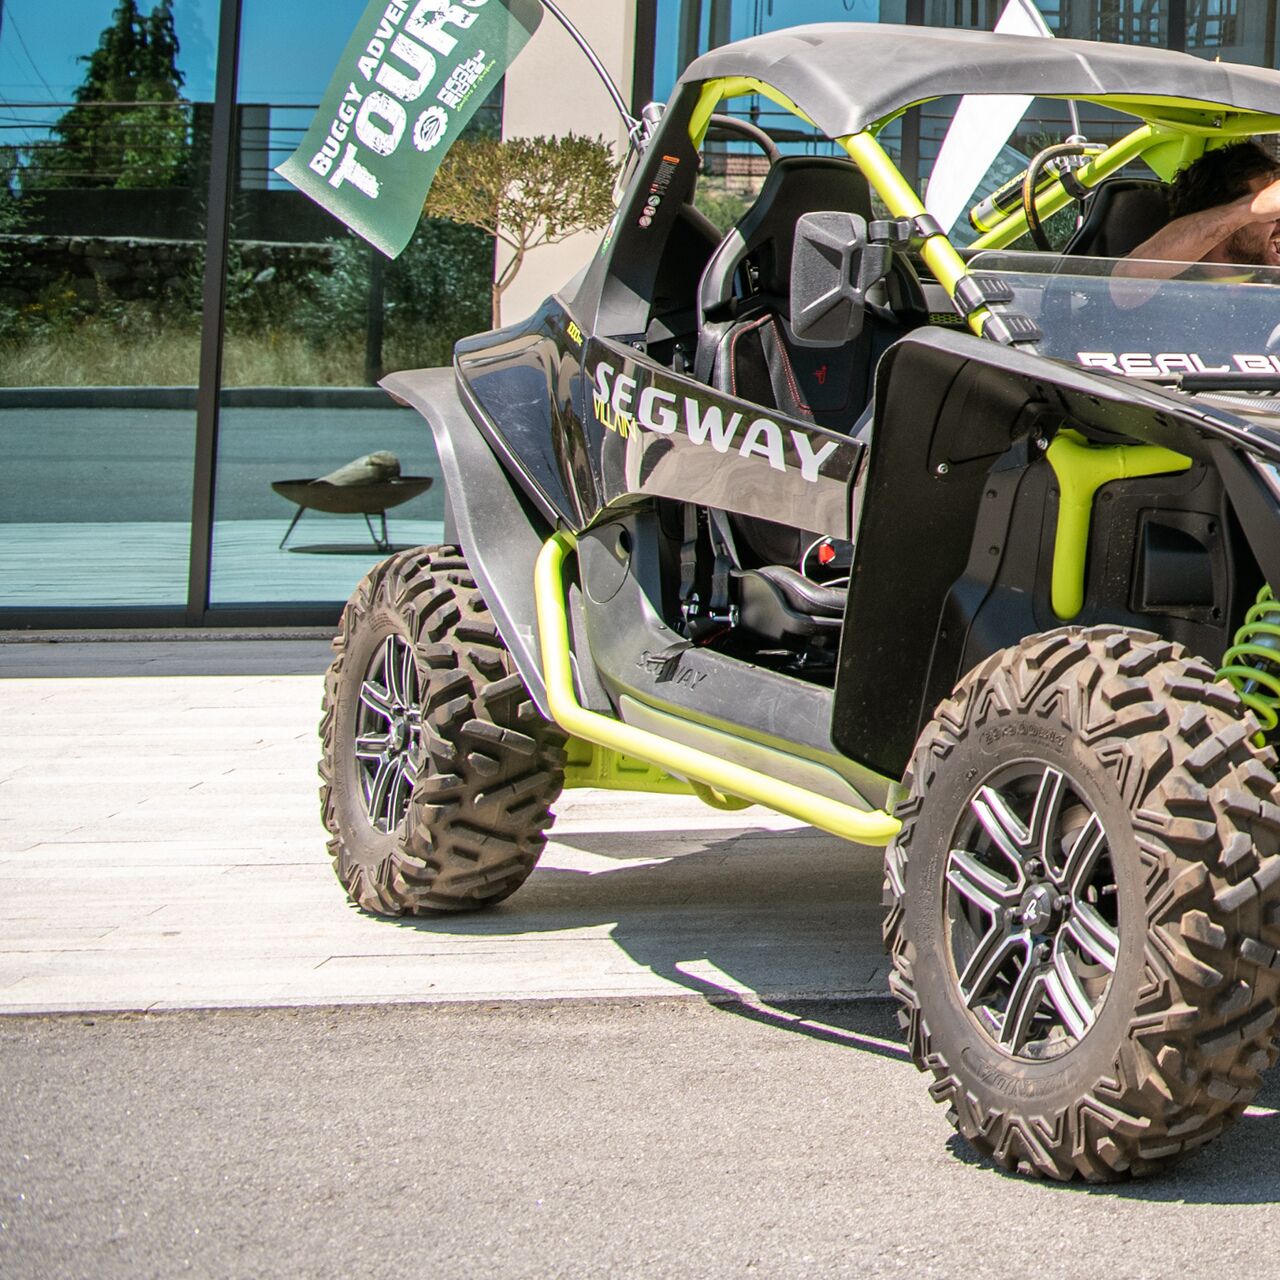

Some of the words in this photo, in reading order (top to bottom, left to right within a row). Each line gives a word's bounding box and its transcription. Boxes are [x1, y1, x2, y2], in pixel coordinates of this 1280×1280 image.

[309, 82, 363, 177] BUGGY
[1077, 351, 1230, 377] REAL
[594, 361, 839, 483] SEGWAY
